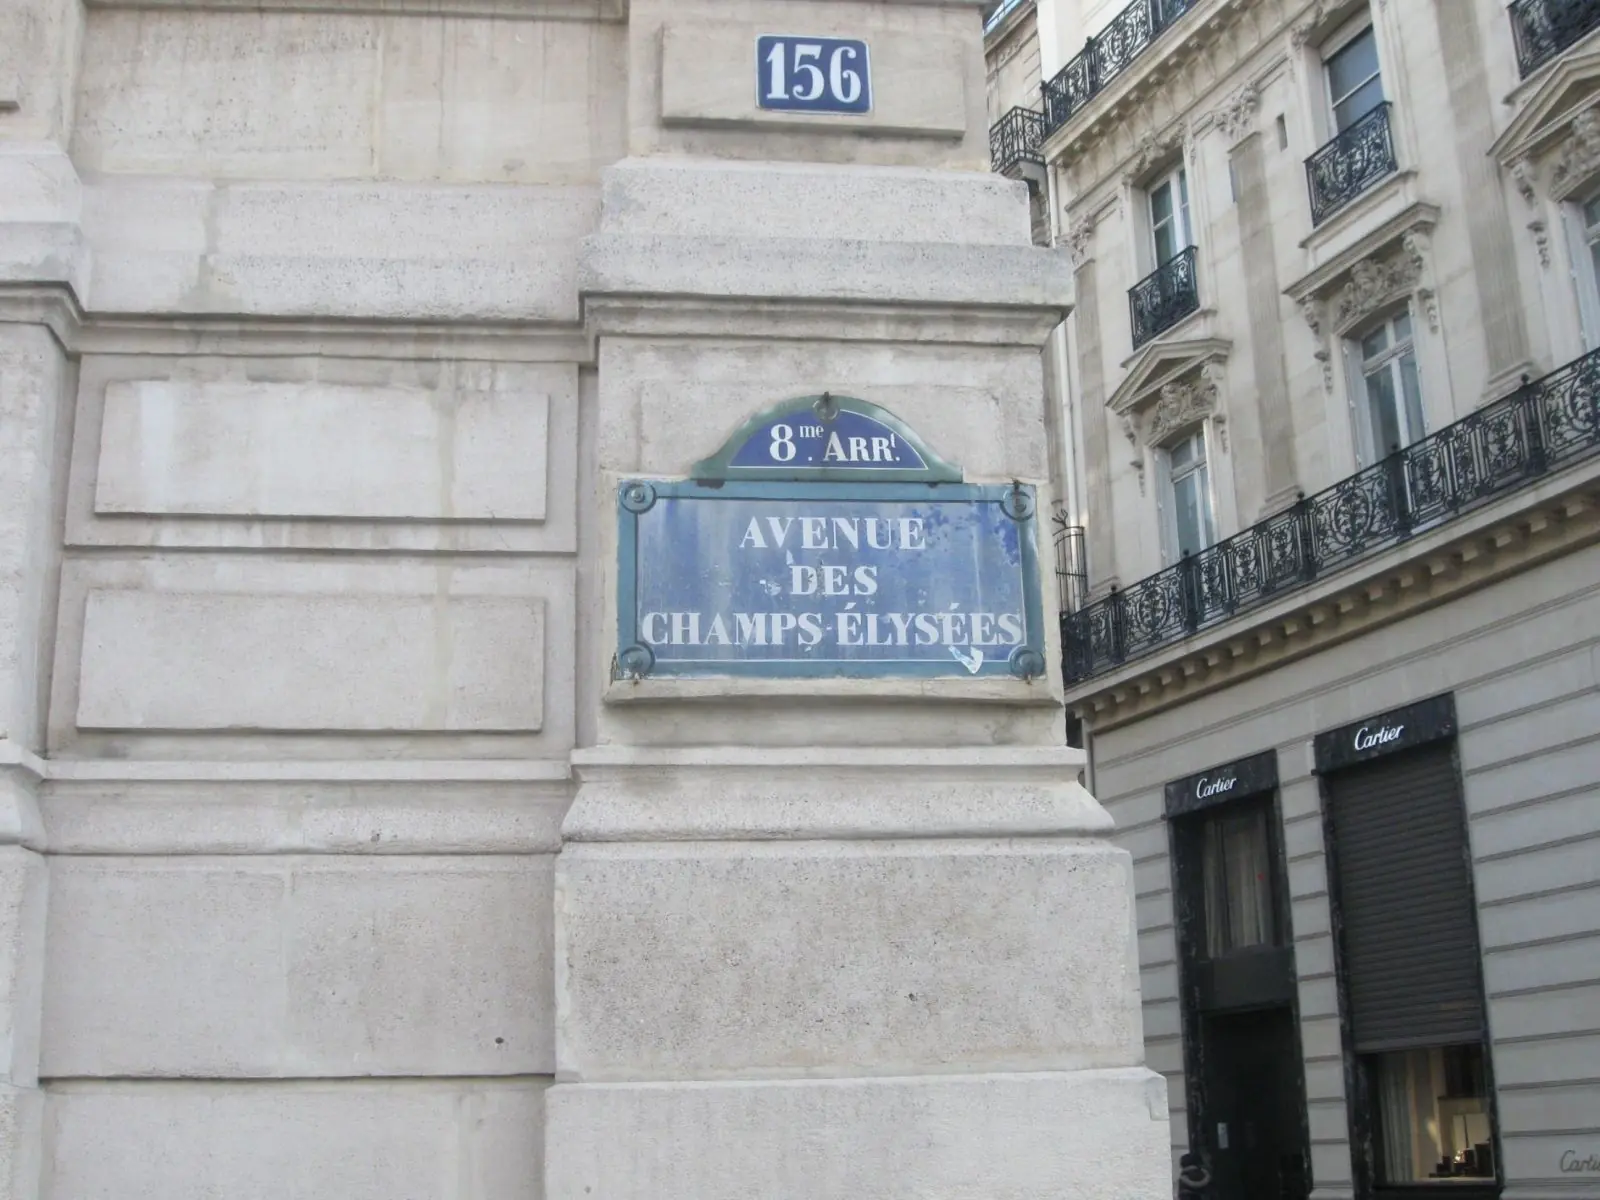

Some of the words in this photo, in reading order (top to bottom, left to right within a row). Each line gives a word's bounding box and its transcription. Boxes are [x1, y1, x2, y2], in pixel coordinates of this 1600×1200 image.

[766, 42, 861, 103] 156
[739, 516, 926, 549] AVENUE
[789, 565, 878, 596] DES
[1354, 725, 1404, 751] Cartier
[1196, 777, 1237, 800] Cartier
